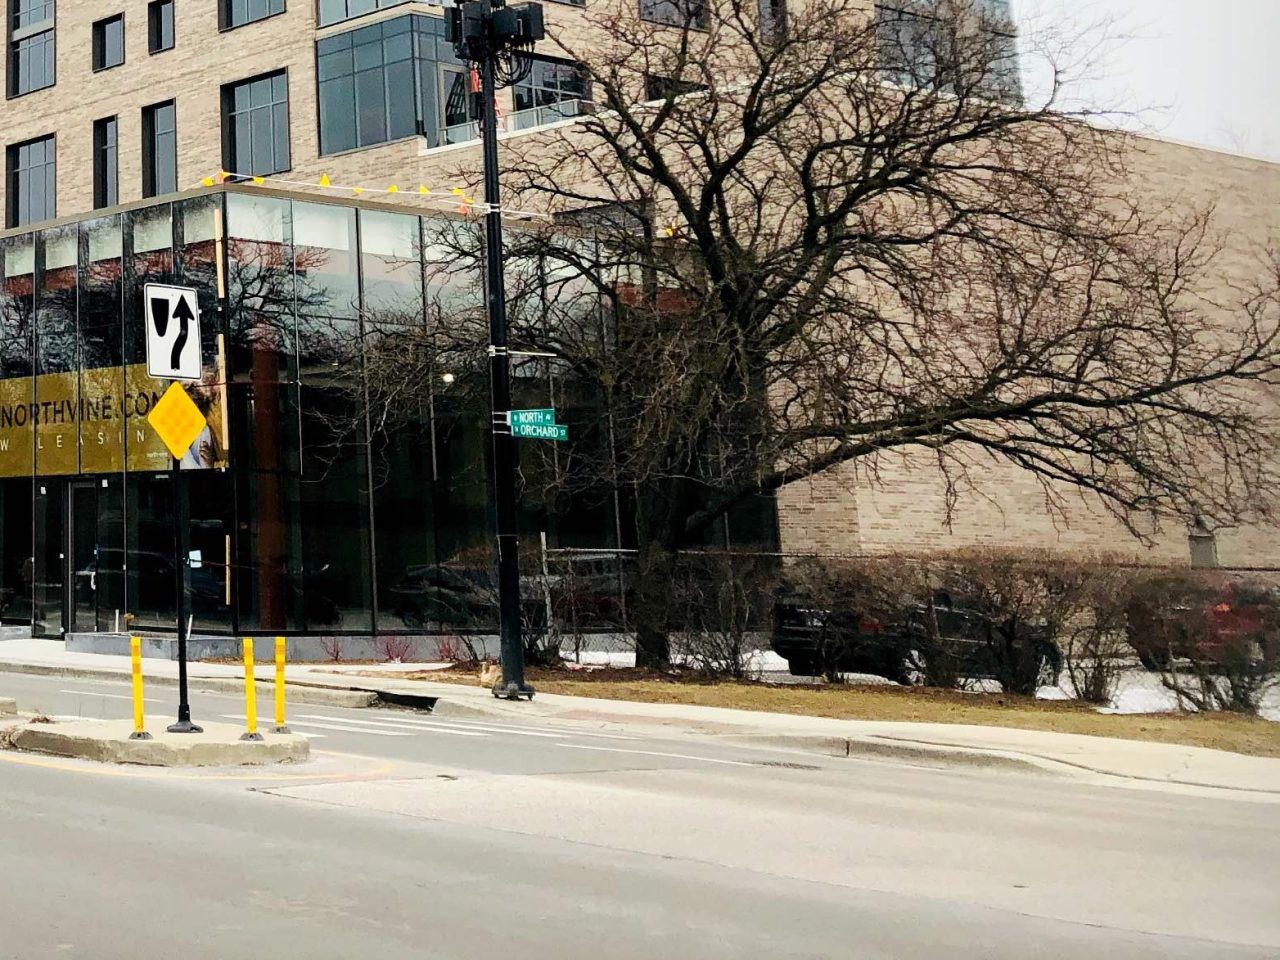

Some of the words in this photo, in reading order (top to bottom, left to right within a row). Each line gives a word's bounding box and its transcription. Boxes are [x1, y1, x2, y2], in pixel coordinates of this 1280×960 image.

[519, 412, 544, 423] NORTH
[520, 424, 559, 438] ORCHARD
[37, 429, 145, 450] LEASIN
